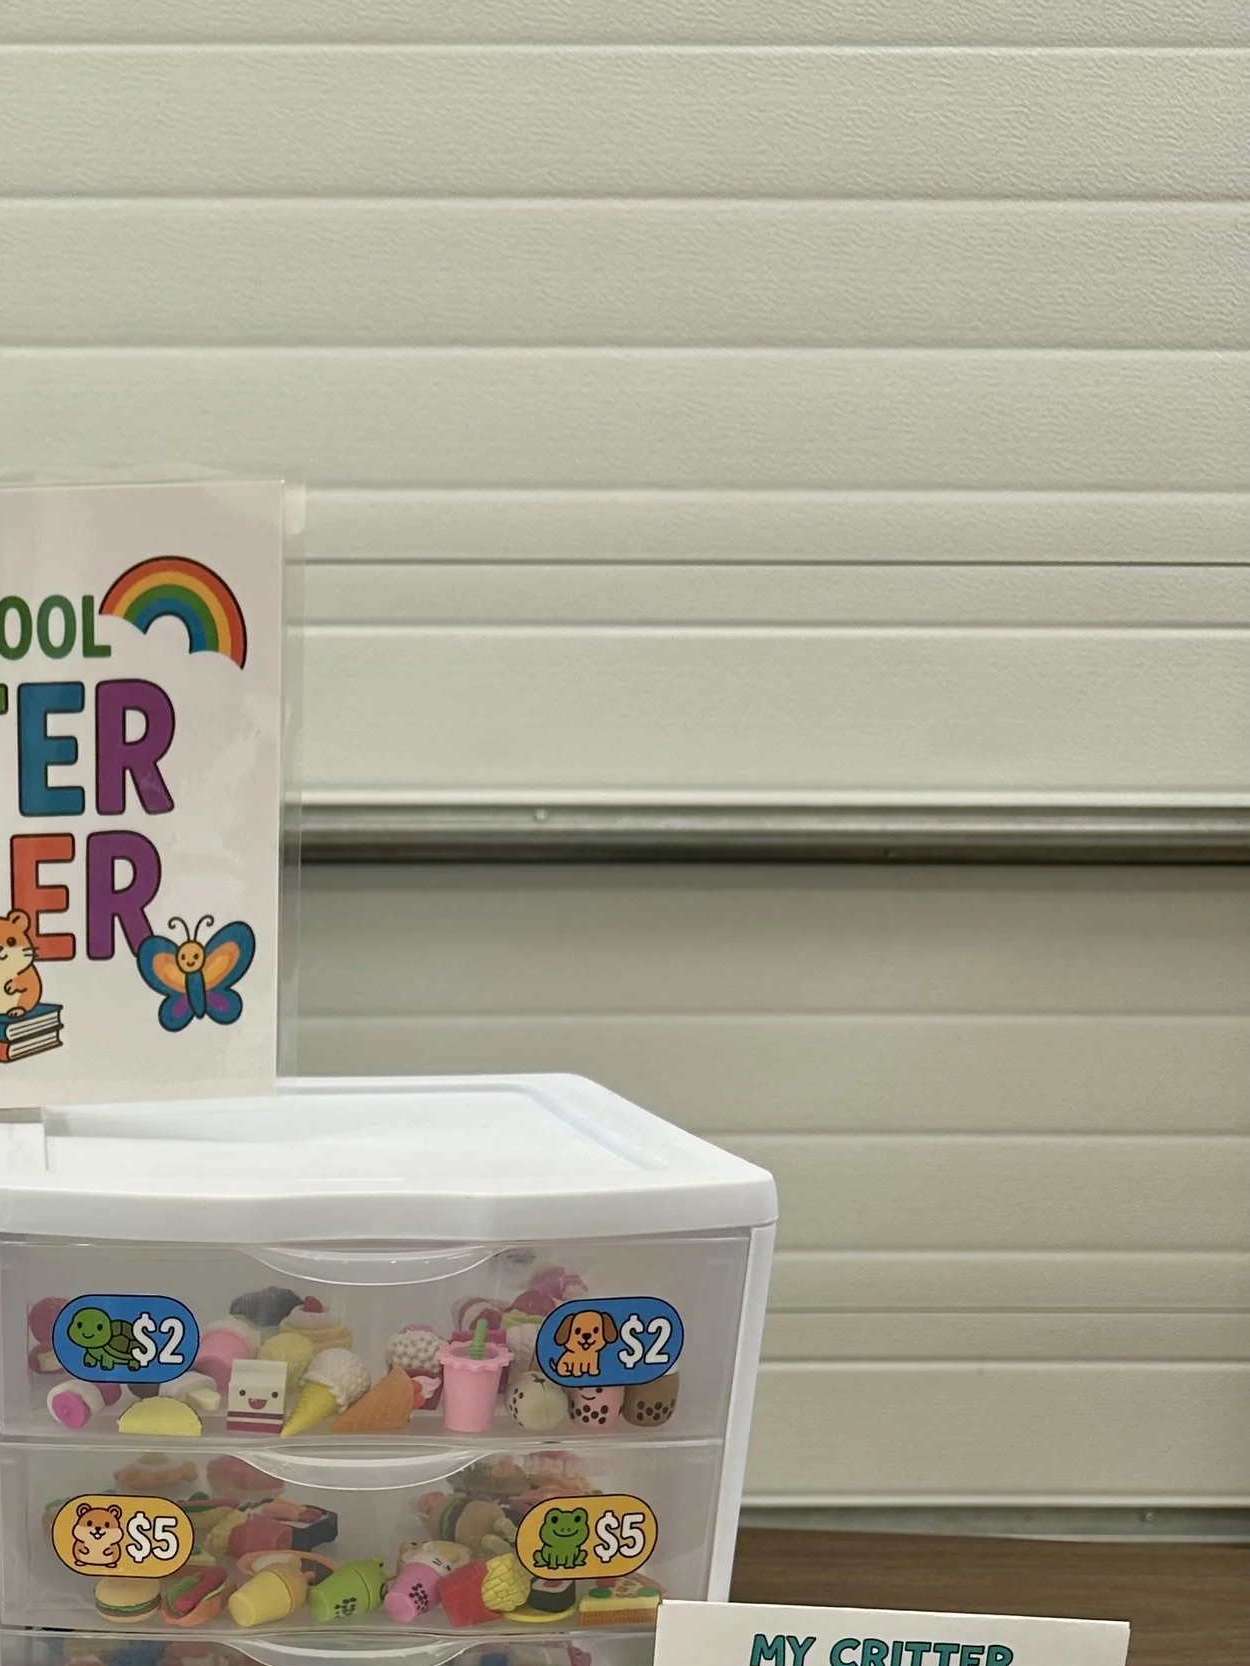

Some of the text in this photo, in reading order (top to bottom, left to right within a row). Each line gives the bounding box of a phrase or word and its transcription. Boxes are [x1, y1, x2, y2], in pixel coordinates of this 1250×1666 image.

[131, 1314, 184, 1365] $2
[618, 1315, 671, 1365] $2
[126, 1514, 179, 1562] $5
[594, 1512, 645, 1562] $5
